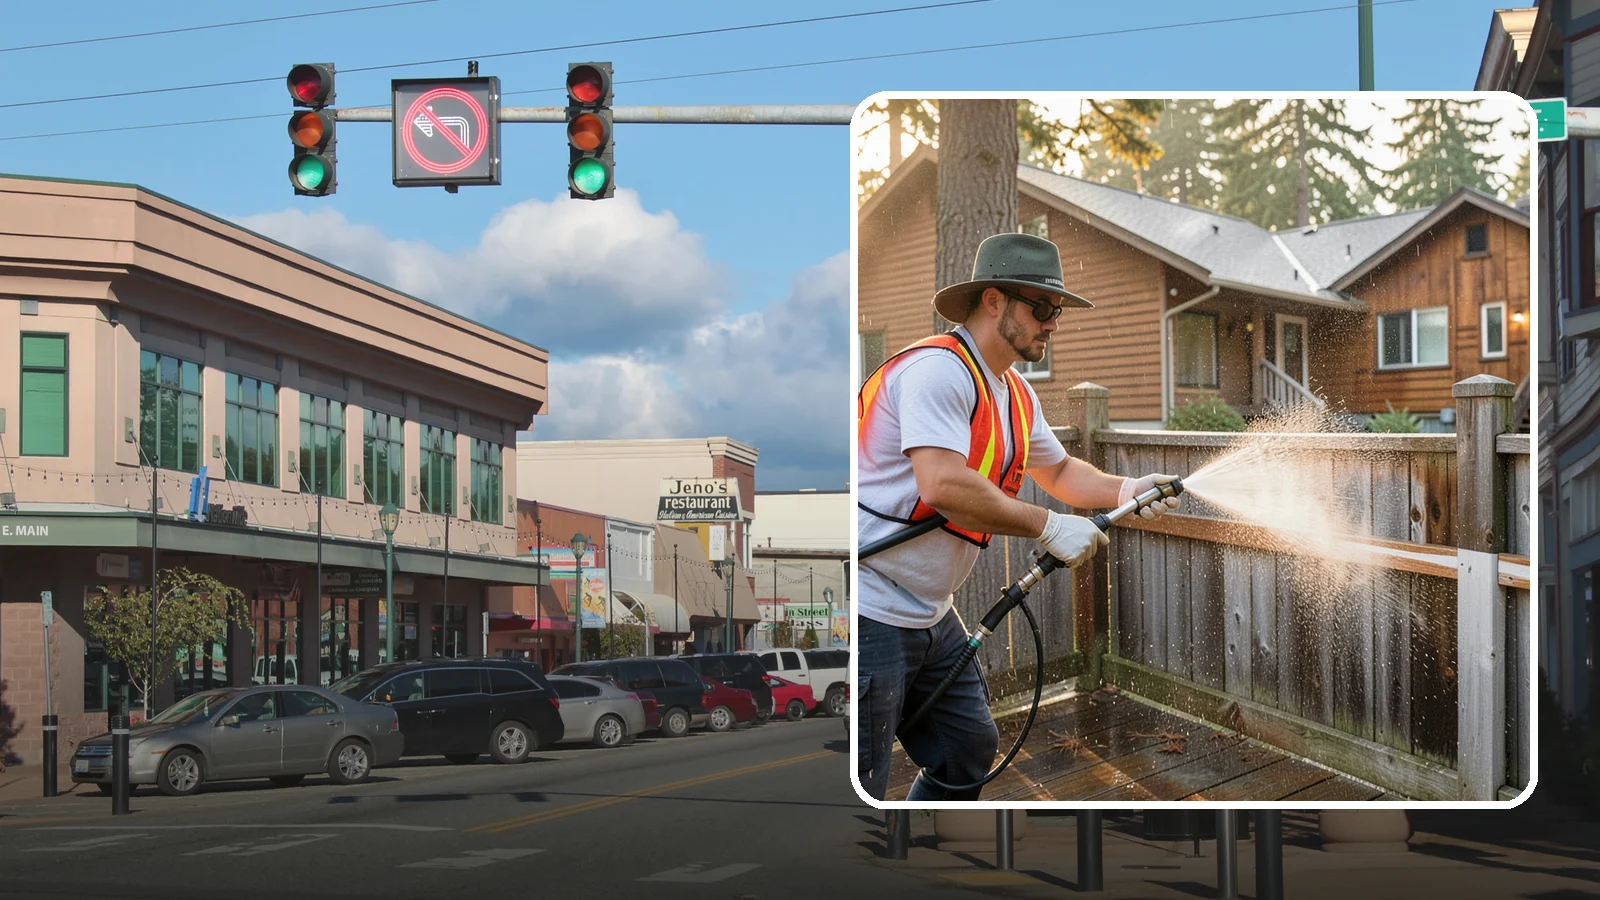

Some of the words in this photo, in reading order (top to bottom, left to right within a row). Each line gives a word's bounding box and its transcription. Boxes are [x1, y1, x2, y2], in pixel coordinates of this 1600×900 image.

[669, 480, 728, 495] Jeno's
[665, 496, 732, 509] restaurant
[686, 509, 715, 519] American
[715, 509, 738, 519] Cuisine
[2, 525, 13, 536] E.
[15, 525, 49, 536] MAIN
[797, 607, 829, 617] Street
